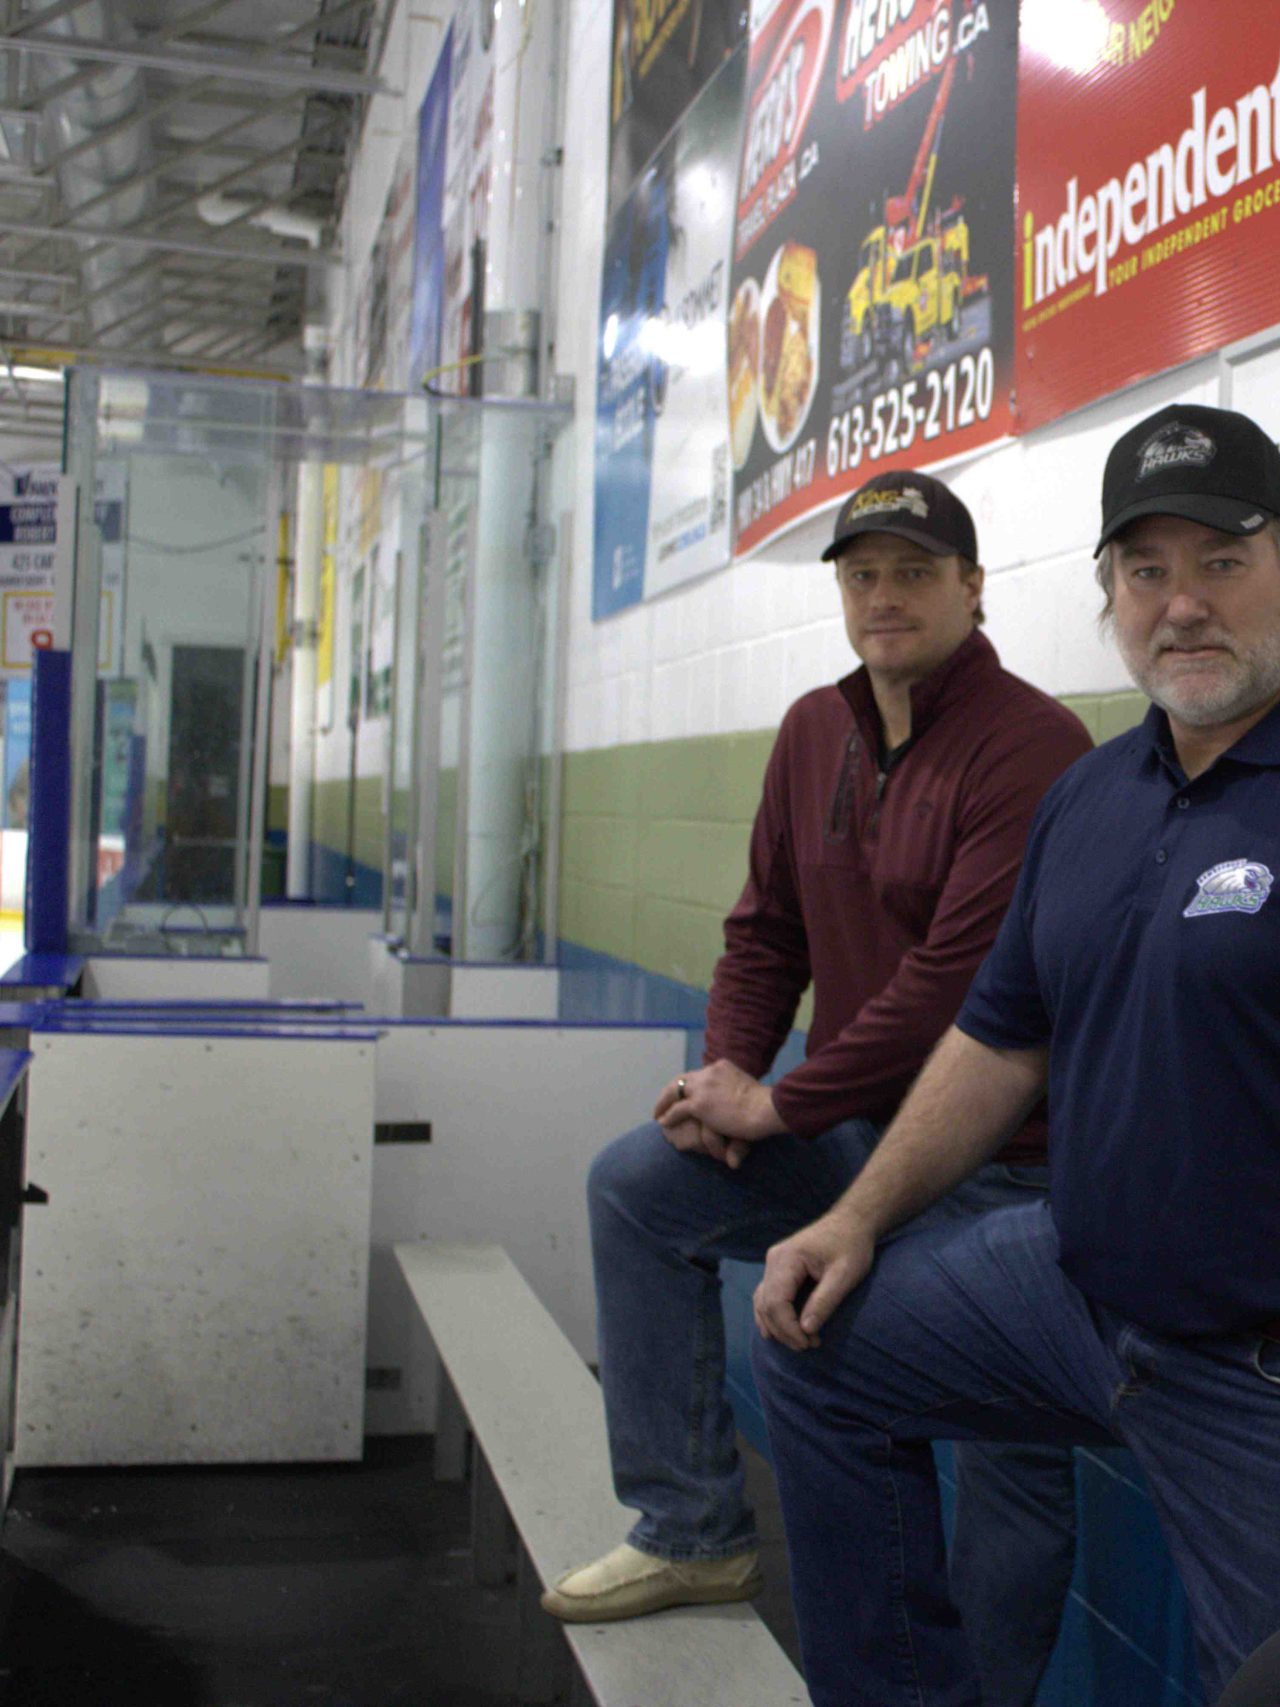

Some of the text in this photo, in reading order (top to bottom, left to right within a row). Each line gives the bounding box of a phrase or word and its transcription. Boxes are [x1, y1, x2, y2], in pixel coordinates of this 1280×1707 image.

[1108, 255, 1139, 289] YOUR
[1141, 206, 1229, 271] INDEPENDENT
[827, 348, 995, 479] 613-525-2120
